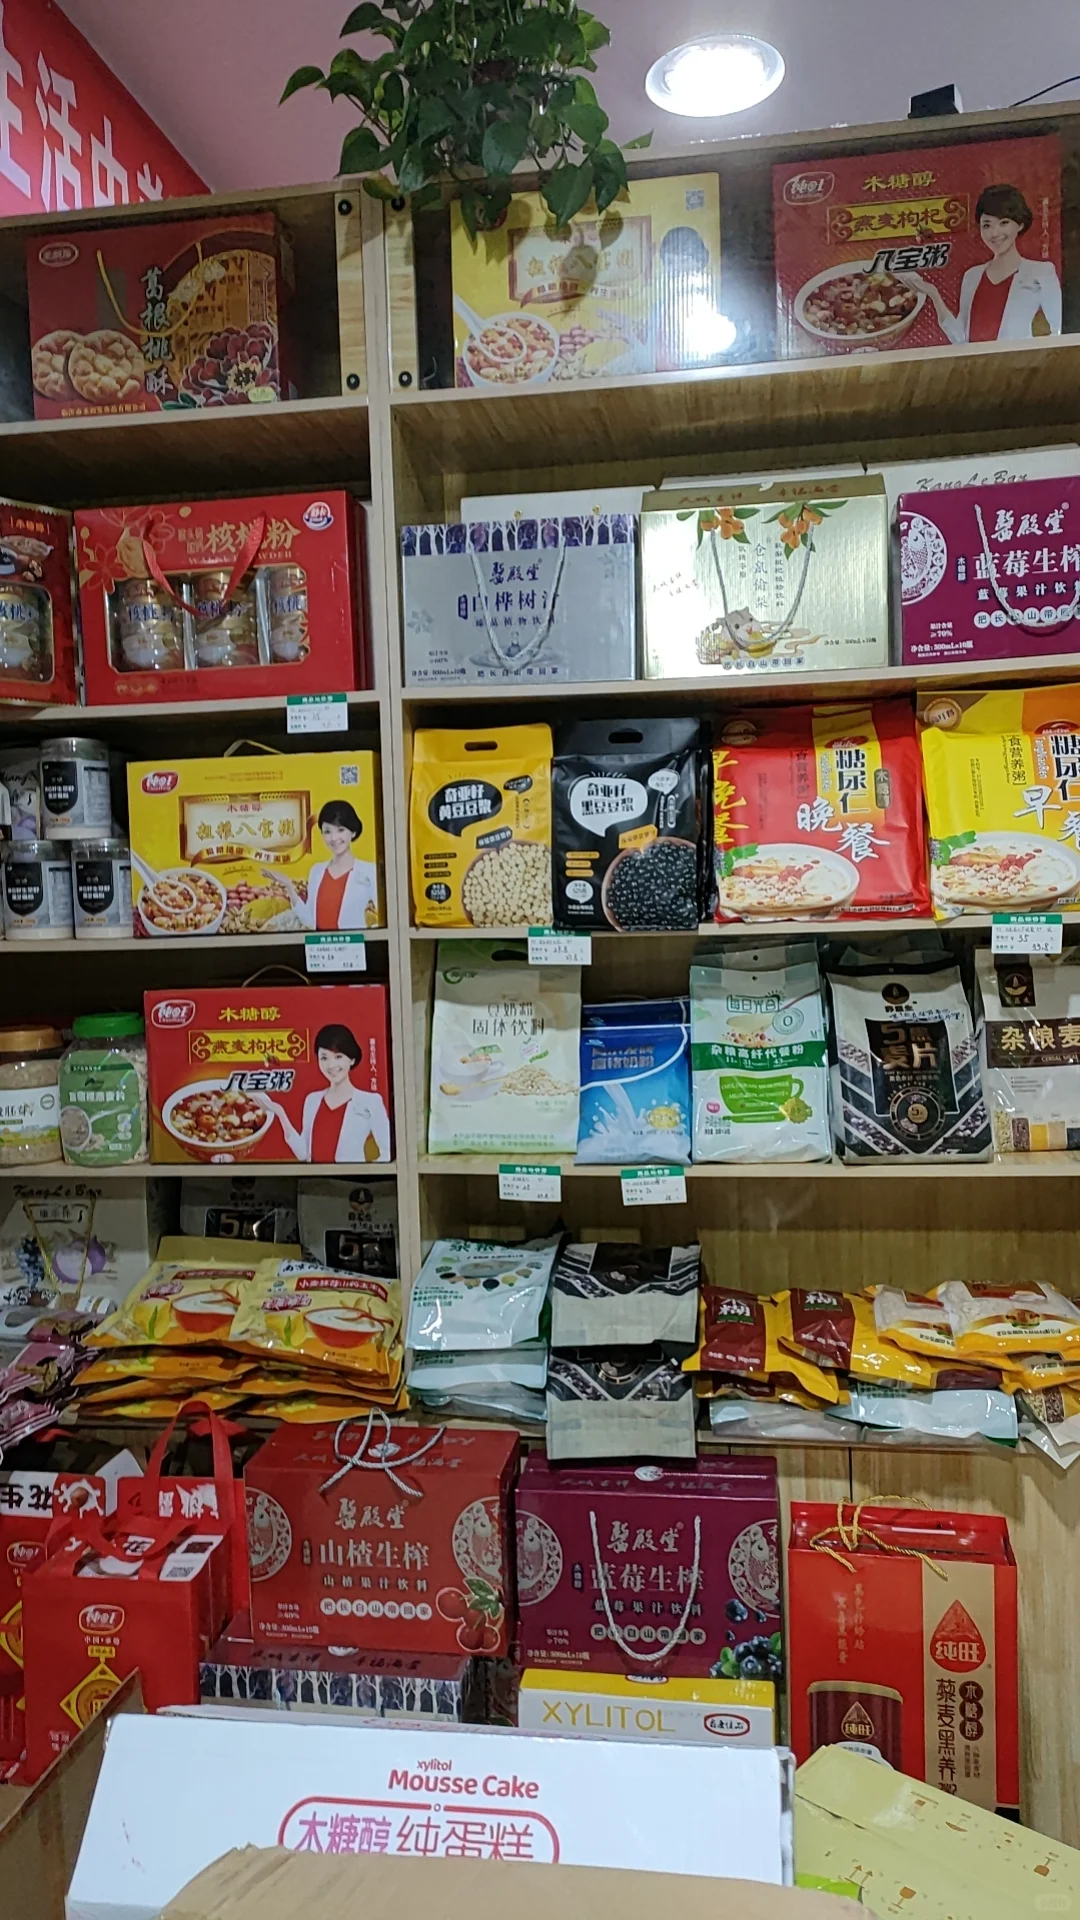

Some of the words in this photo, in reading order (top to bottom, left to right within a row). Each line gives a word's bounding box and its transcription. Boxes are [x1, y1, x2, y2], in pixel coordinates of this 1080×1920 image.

[861, 171, 937, 192] 木糖醇
[852, 207, 945, 233] 燕麦枸杞
[862, 243, 951, 275] 八宝粥
[138, 267, 173, 395] 葛根桃酥
[836, 749, 872, 815] 糖尿仁
[796, 796, 891, 863] 晚餐
[218, 1006, 281, 1021] 木糖醇
[472, 1018, 545, 1037] 固体饮料
[210, 1039, 288, 1055] 燕麦枸杞
[220, 1070, 295, 1092] 八宝粥
[541, 1700, 676, 1733] XYLITOL
[417, 1759, 452, 1772] xylitol
[388, 1769, 478, 1794] Mousse
[482, 1775, 539, 1799] Cake
[295, 1811, 392, 1854] 木糖醇
[396, 1815, 534, 1860] 纯蛋糕
